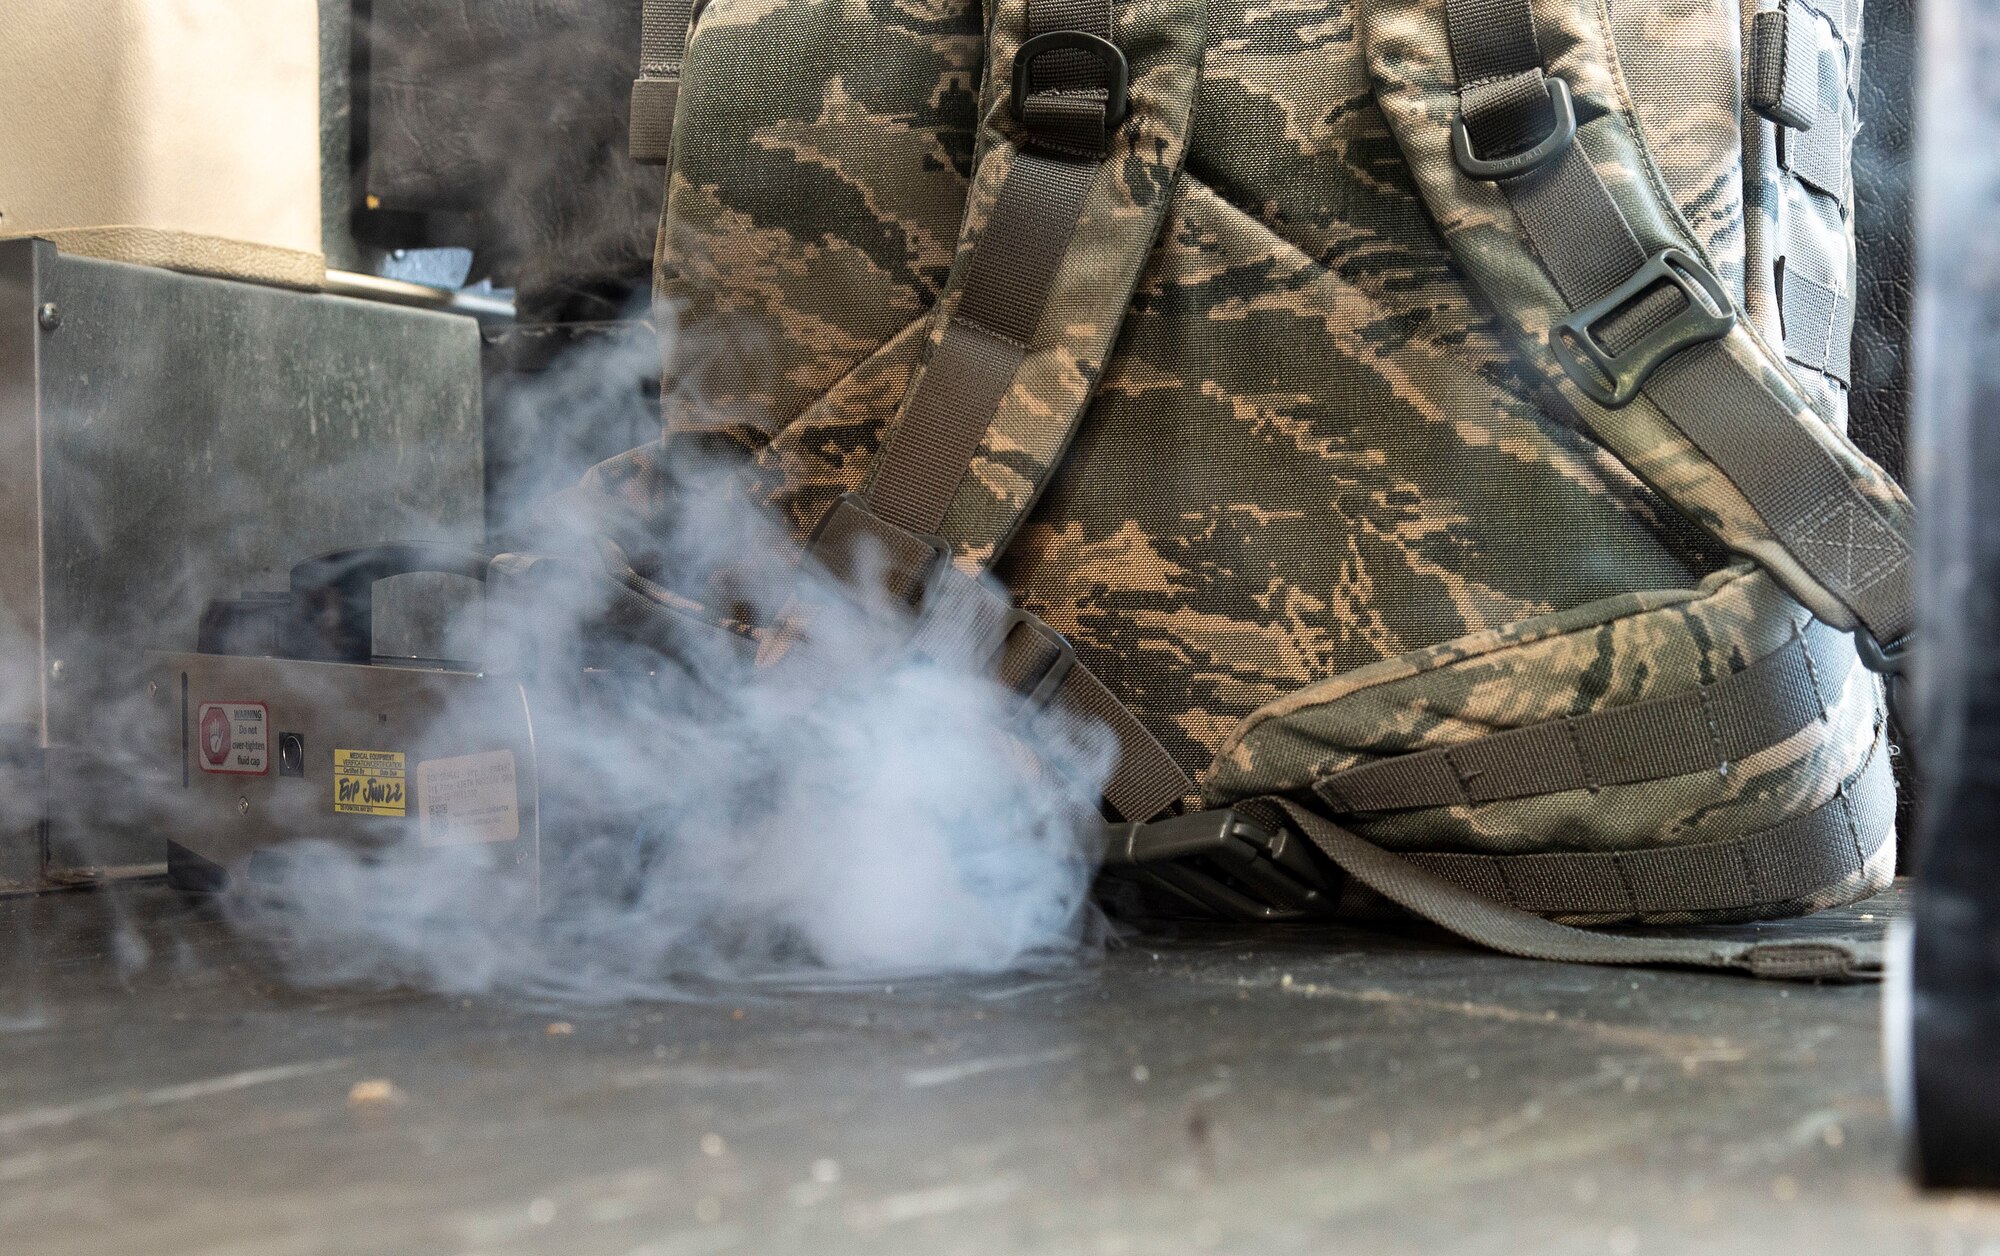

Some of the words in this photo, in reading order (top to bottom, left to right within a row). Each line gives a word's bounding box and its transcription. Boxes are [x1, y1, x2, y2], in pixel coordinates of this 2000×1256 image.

[1491, 158, 1521, 170] NEXUS
[234, 709, 262, 719] WARNING
[239, 726, 247, 735] Do
[247, 726, 257, 735] not
[232, 742, 264, 752] over-tighten
[237, 755, 249, 765] fluid
[250, 757, 260, 767] cap
[350, 752, 368, 760] MEDICAL
[369, 753, 394, 761] EQUIPMENT
